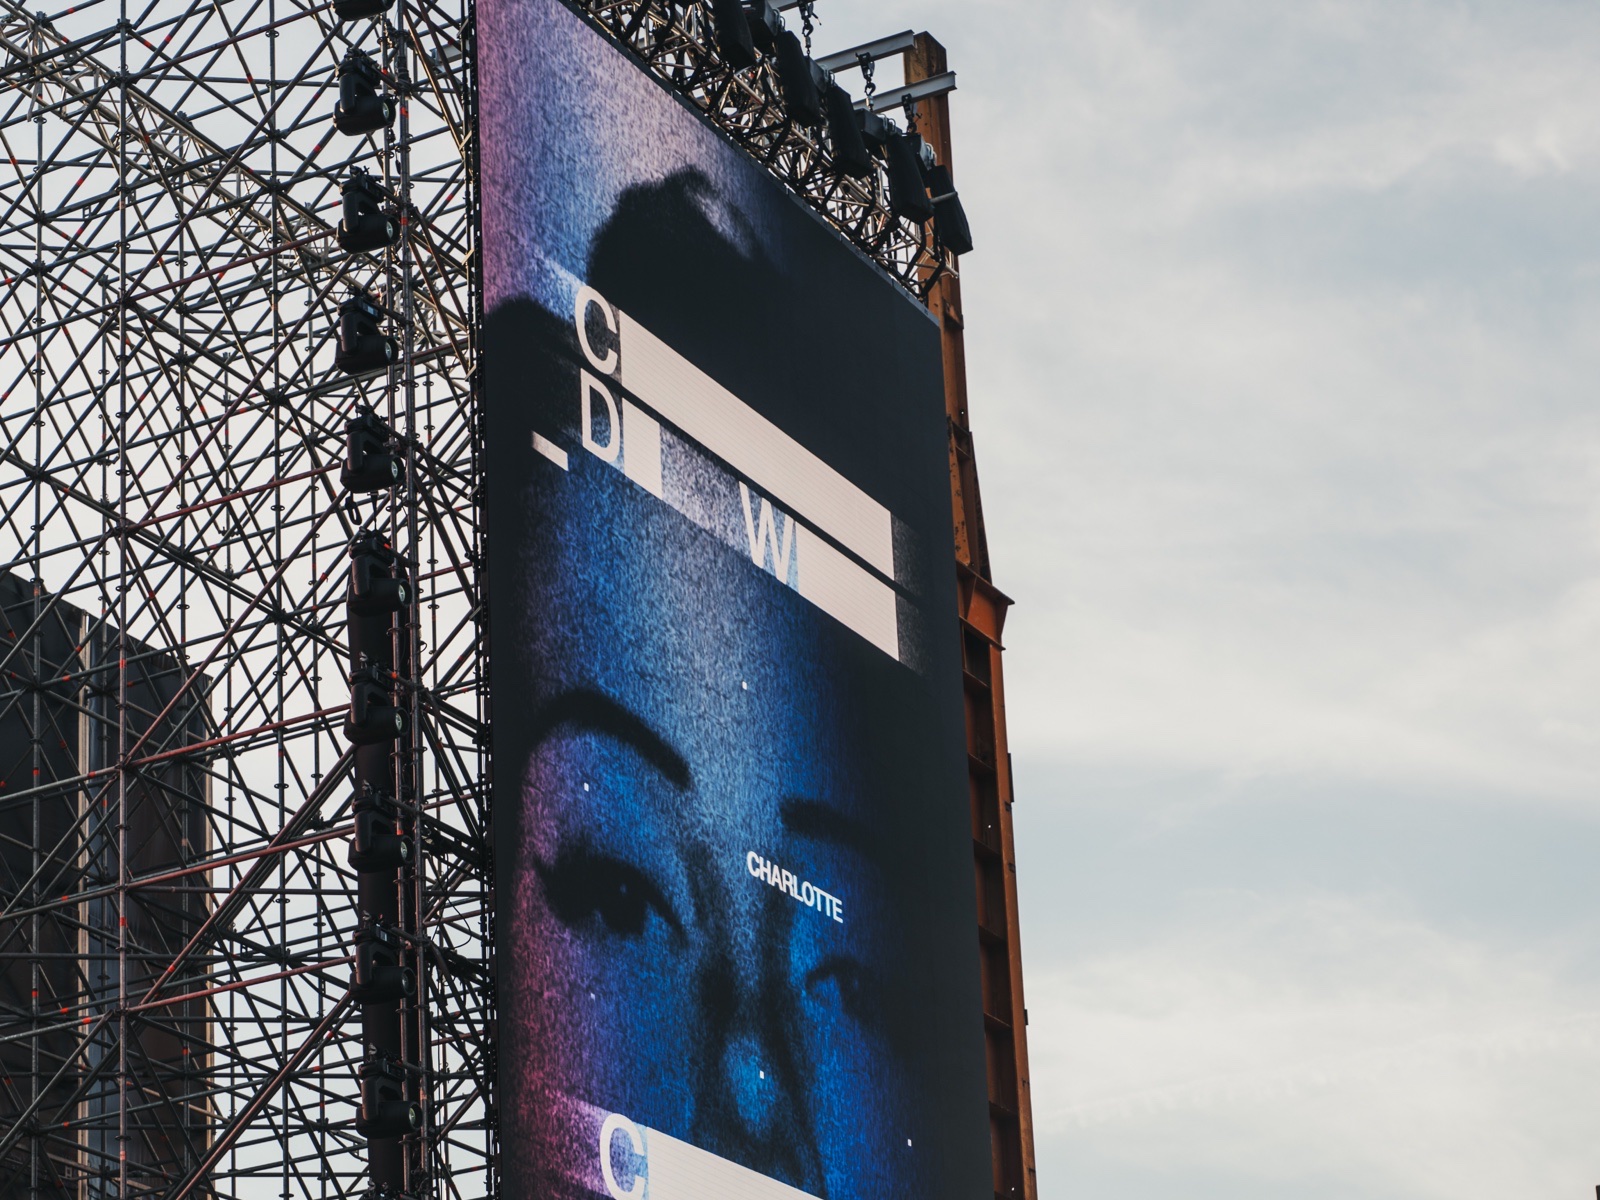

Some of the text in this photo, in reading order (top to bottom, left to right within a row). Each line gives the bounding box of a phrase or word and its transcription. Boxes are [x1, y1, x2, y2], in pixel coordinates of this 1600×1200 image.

[574, 286, 617, 374] C
[580, 368, 795, 584] D W
[746, 850, 843, 924] CHARLOTTE
